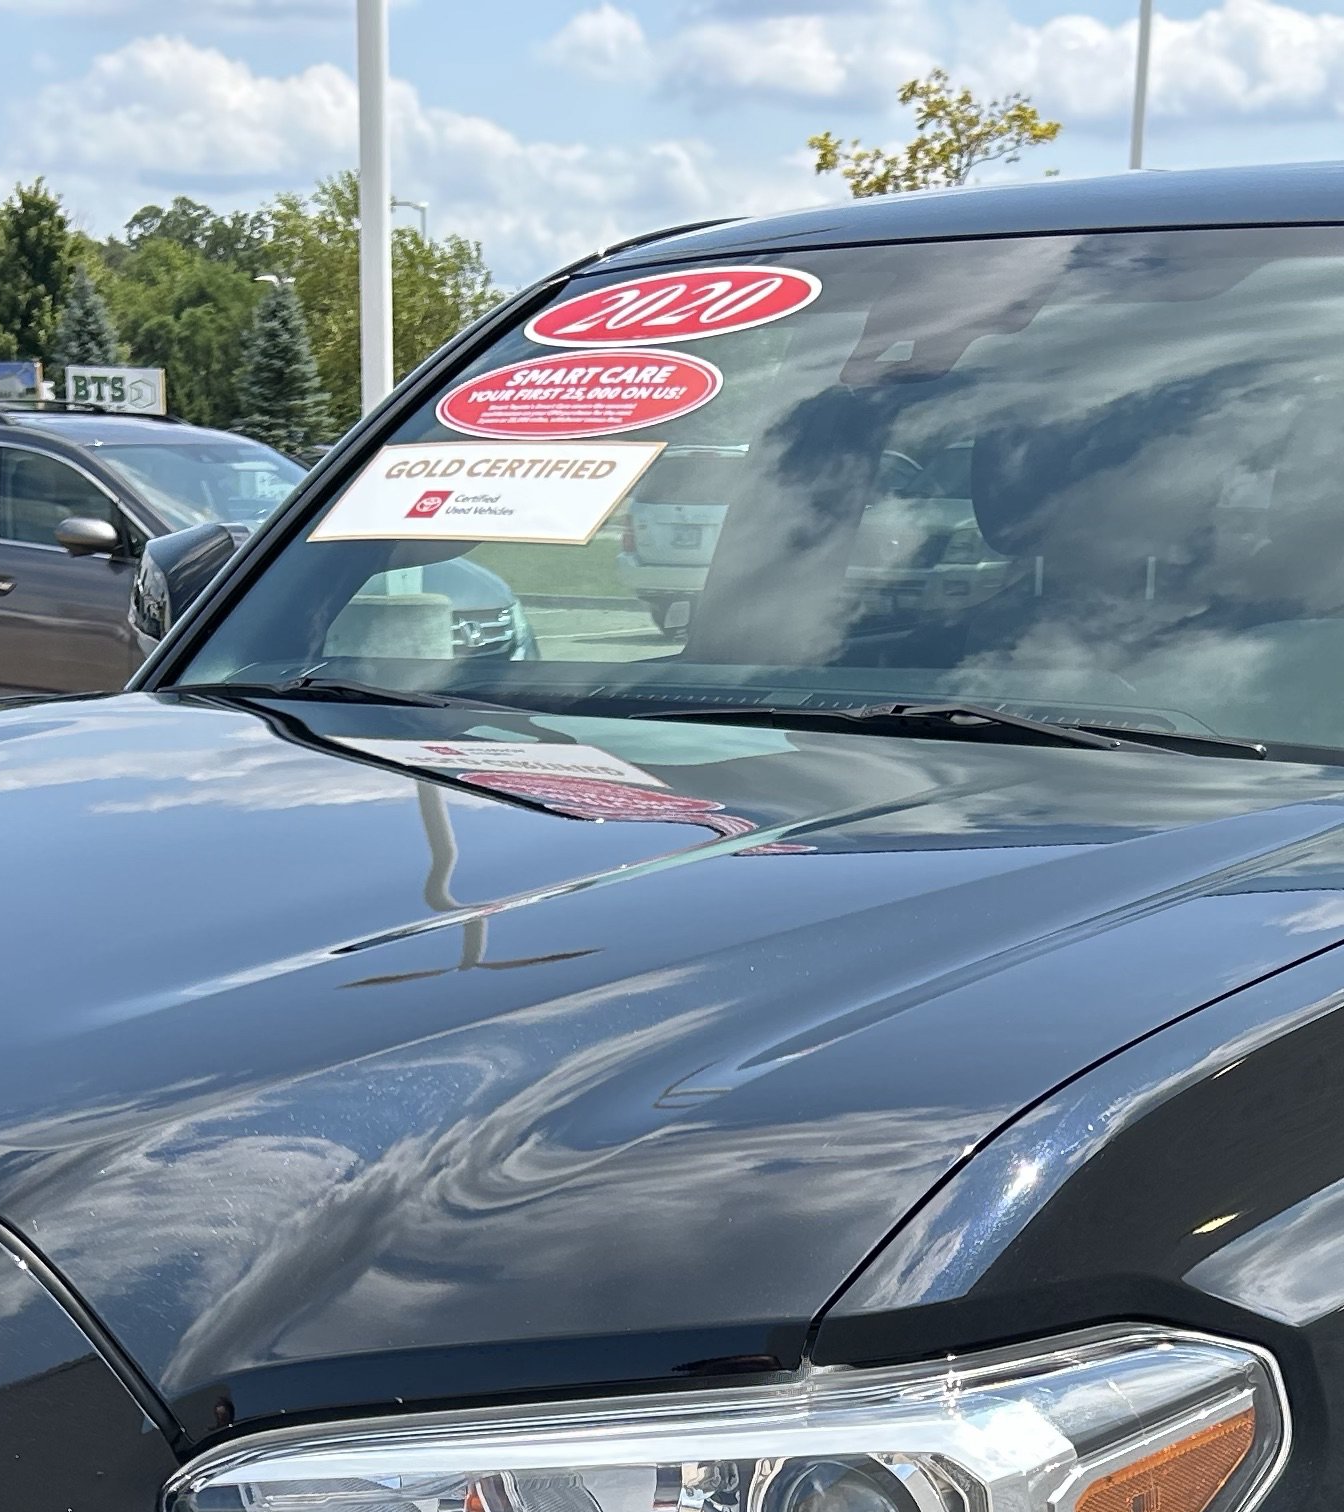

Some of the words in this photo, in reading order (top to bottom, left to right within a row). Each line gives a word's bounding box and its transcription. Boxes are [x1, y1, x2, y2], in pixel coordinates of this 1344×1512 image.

[553, 277, 783, 335] 2020
[506, 367, 605, 387] SMART
[599, 365, 677, 385] CARE
[73, 375, 125, 401] BTS
[468, 389, 517, 403] YOUR
[513, 388, 561, 402] FIRST
[560, 387, 623, 402] 25,000
[621, 387, 652, 400] ON
[652, 386, 687, 400] US!
[385, 458, 465, 480] GOLD
[466, 458, 617, 480] CERTIFIED
[454, 493, 502, 504] Certified
[445, 505, 472, 516] Used
[473, 506, 515, 517] Vehicles
